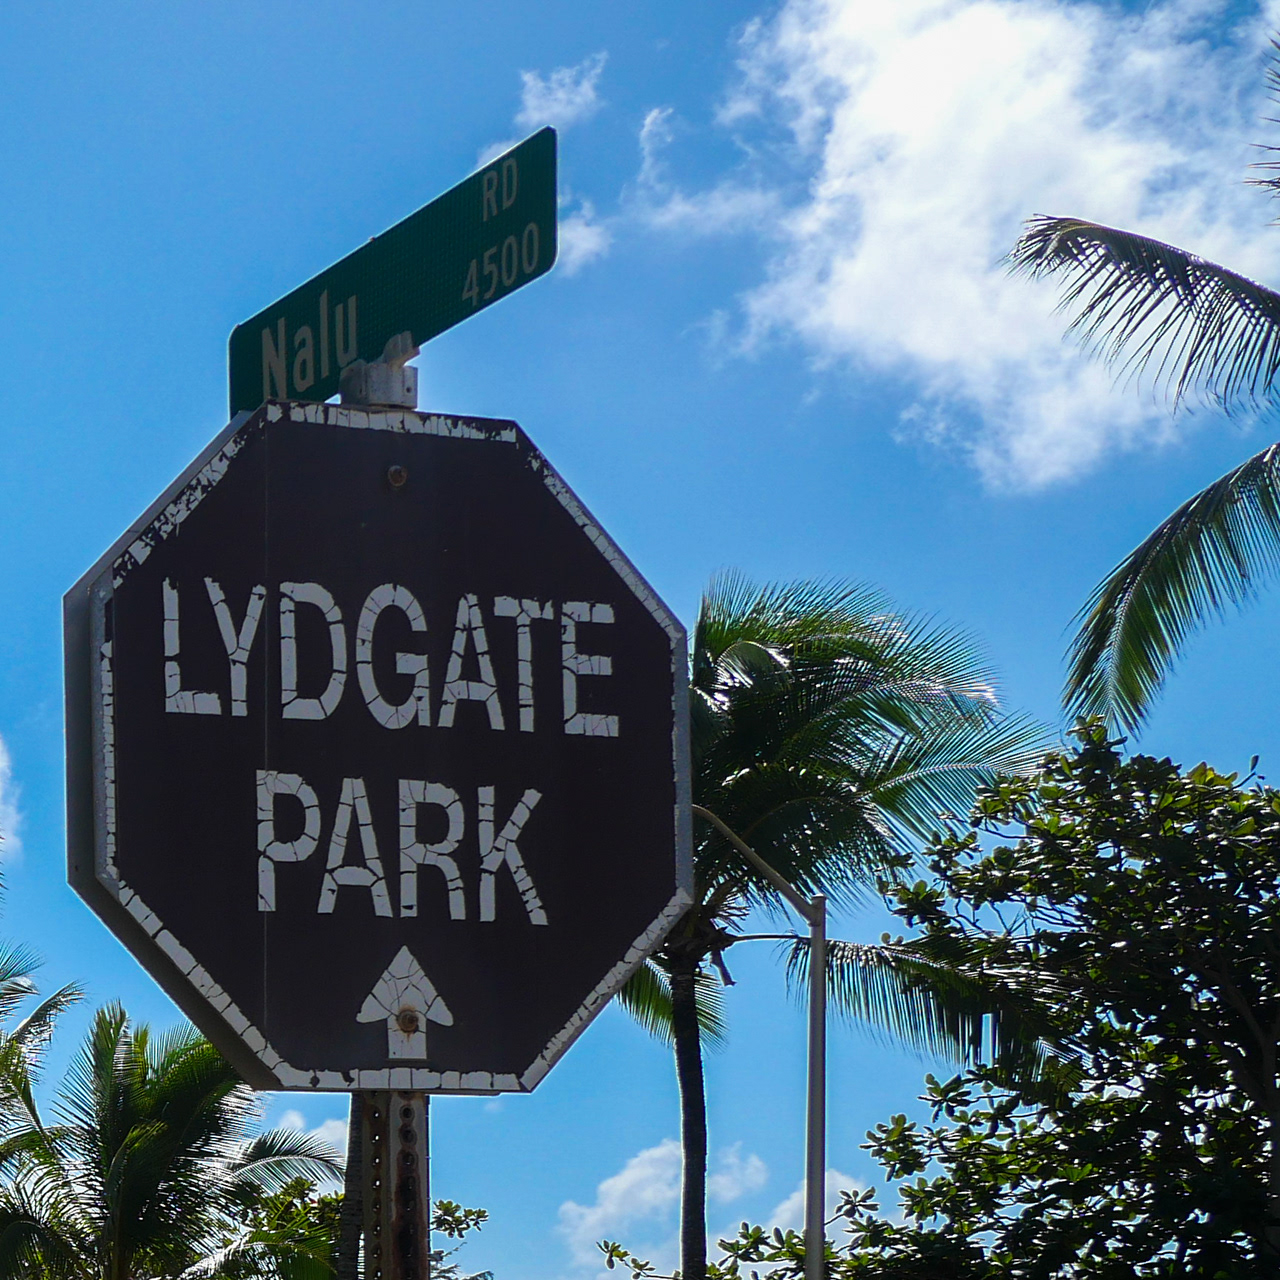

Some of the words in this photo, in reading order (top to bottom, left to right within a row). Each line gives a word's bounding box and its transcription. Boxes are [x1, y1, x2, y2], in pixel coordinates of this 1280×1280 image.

[261, 288, 358, 400] Nalu
[482, 157, 518, 222] RD
[461, 221, 540, 307] 4500
[161, 576, 620, 738] LYDGATE
[255, 769, 549, 926] PARK
